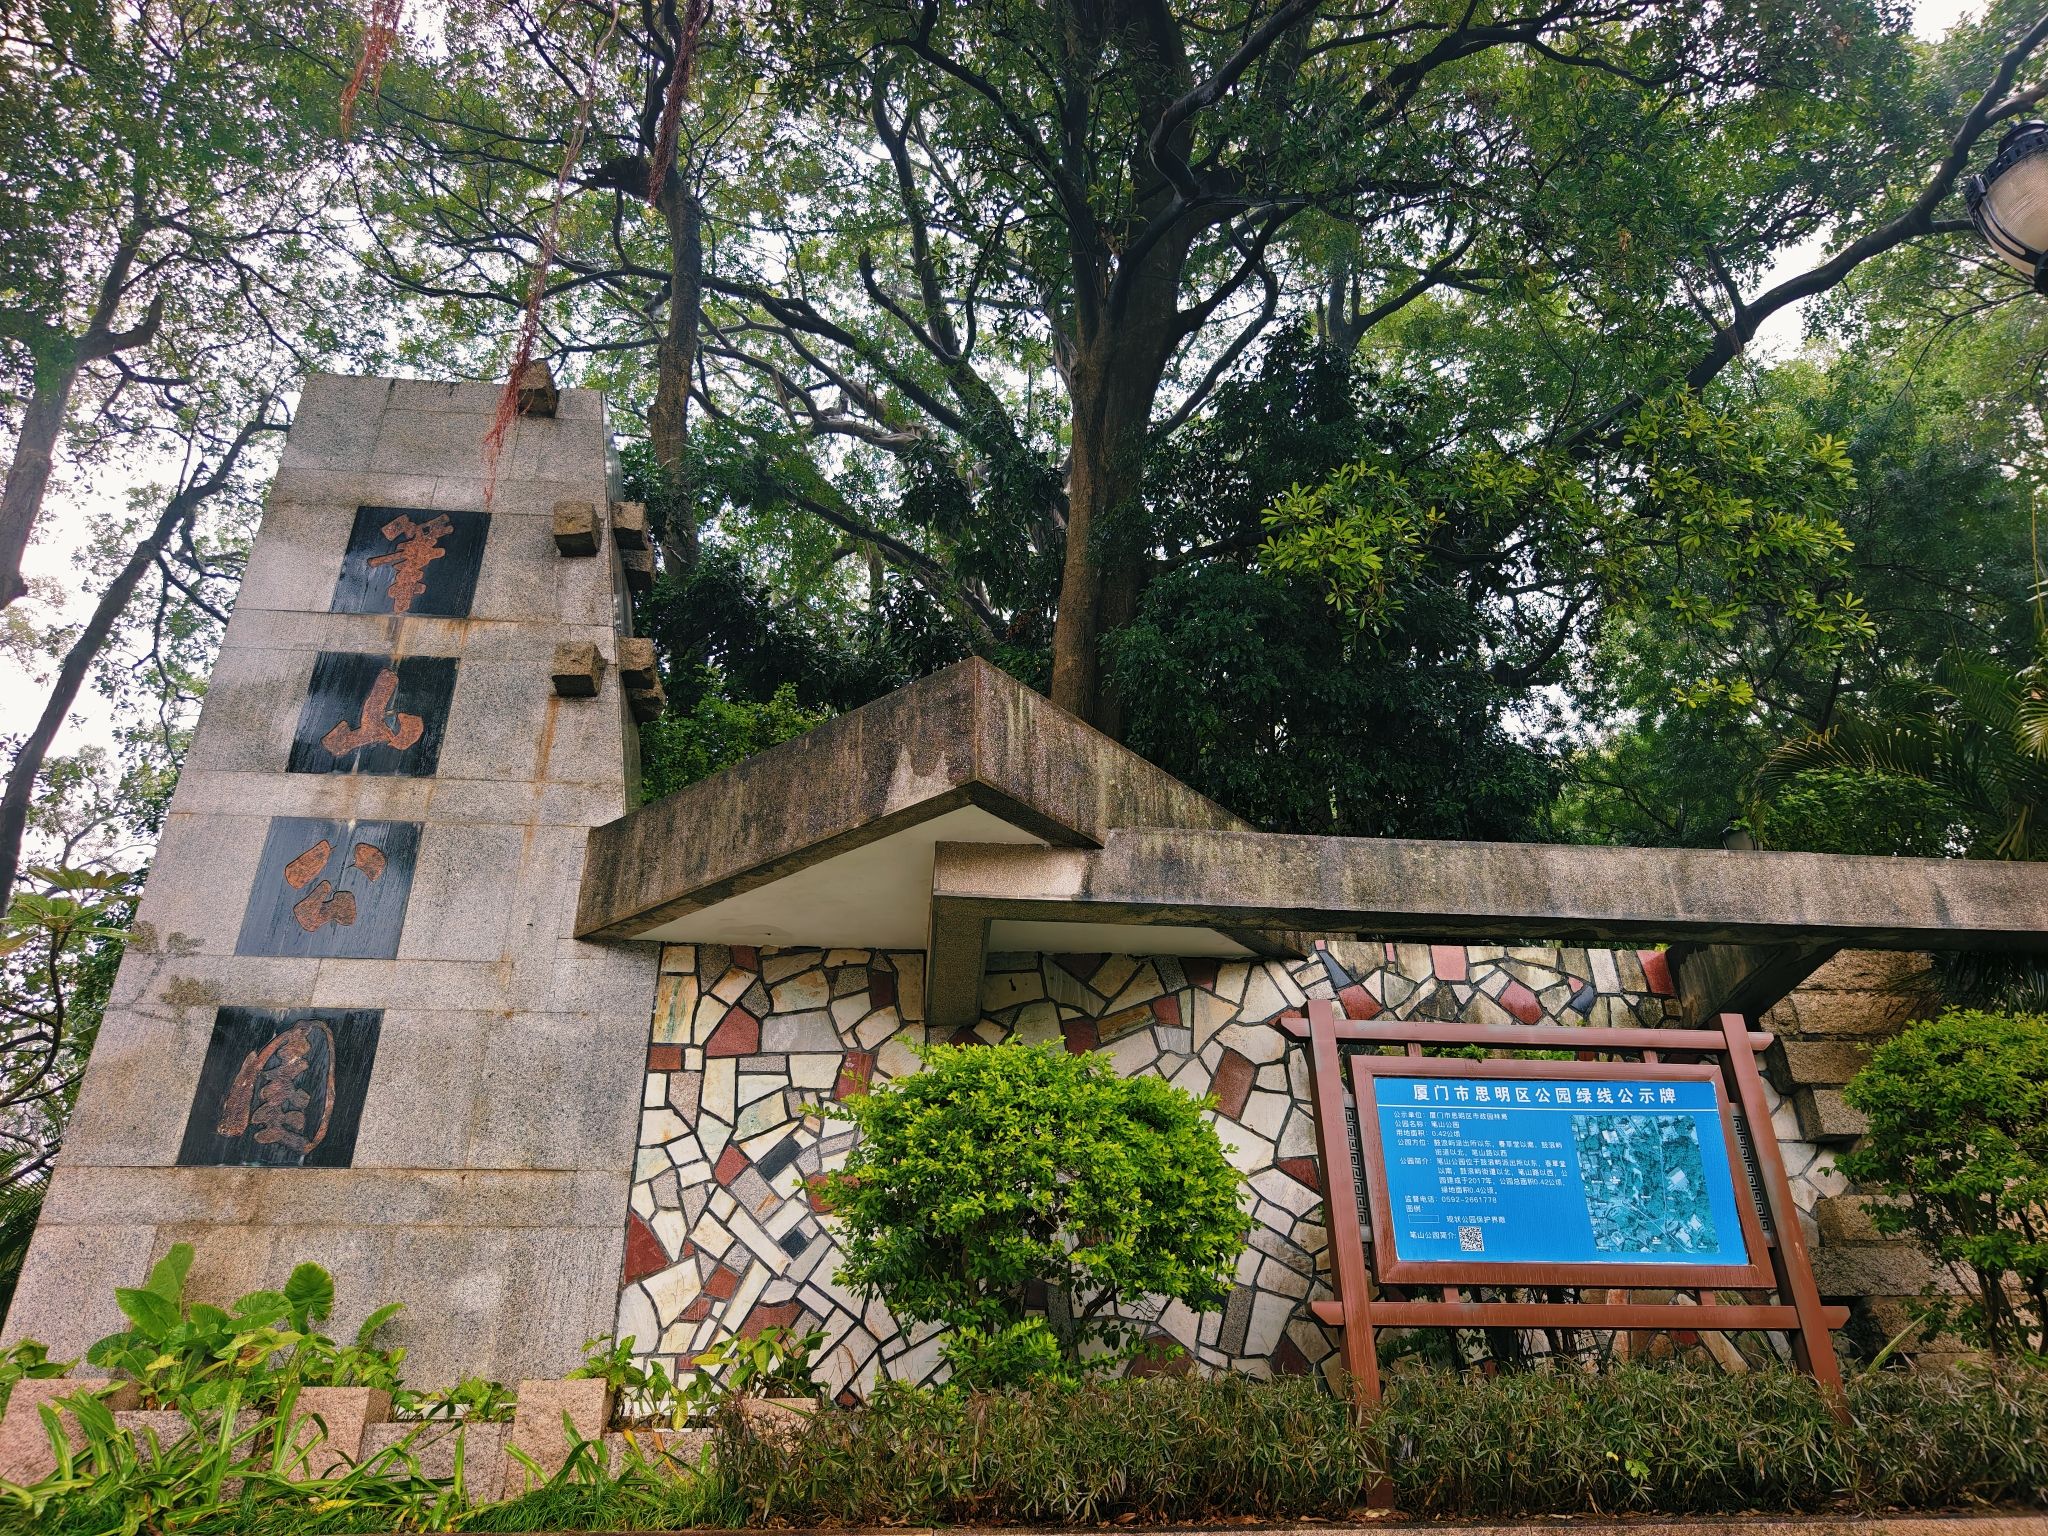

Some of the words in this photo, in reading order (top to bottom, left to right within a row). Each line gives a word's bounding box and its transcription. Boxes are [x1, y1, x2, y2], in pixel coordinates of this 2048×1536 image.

[1412, 1084, 1678, 1104] 厦门市思明区公园绿线公示牌
